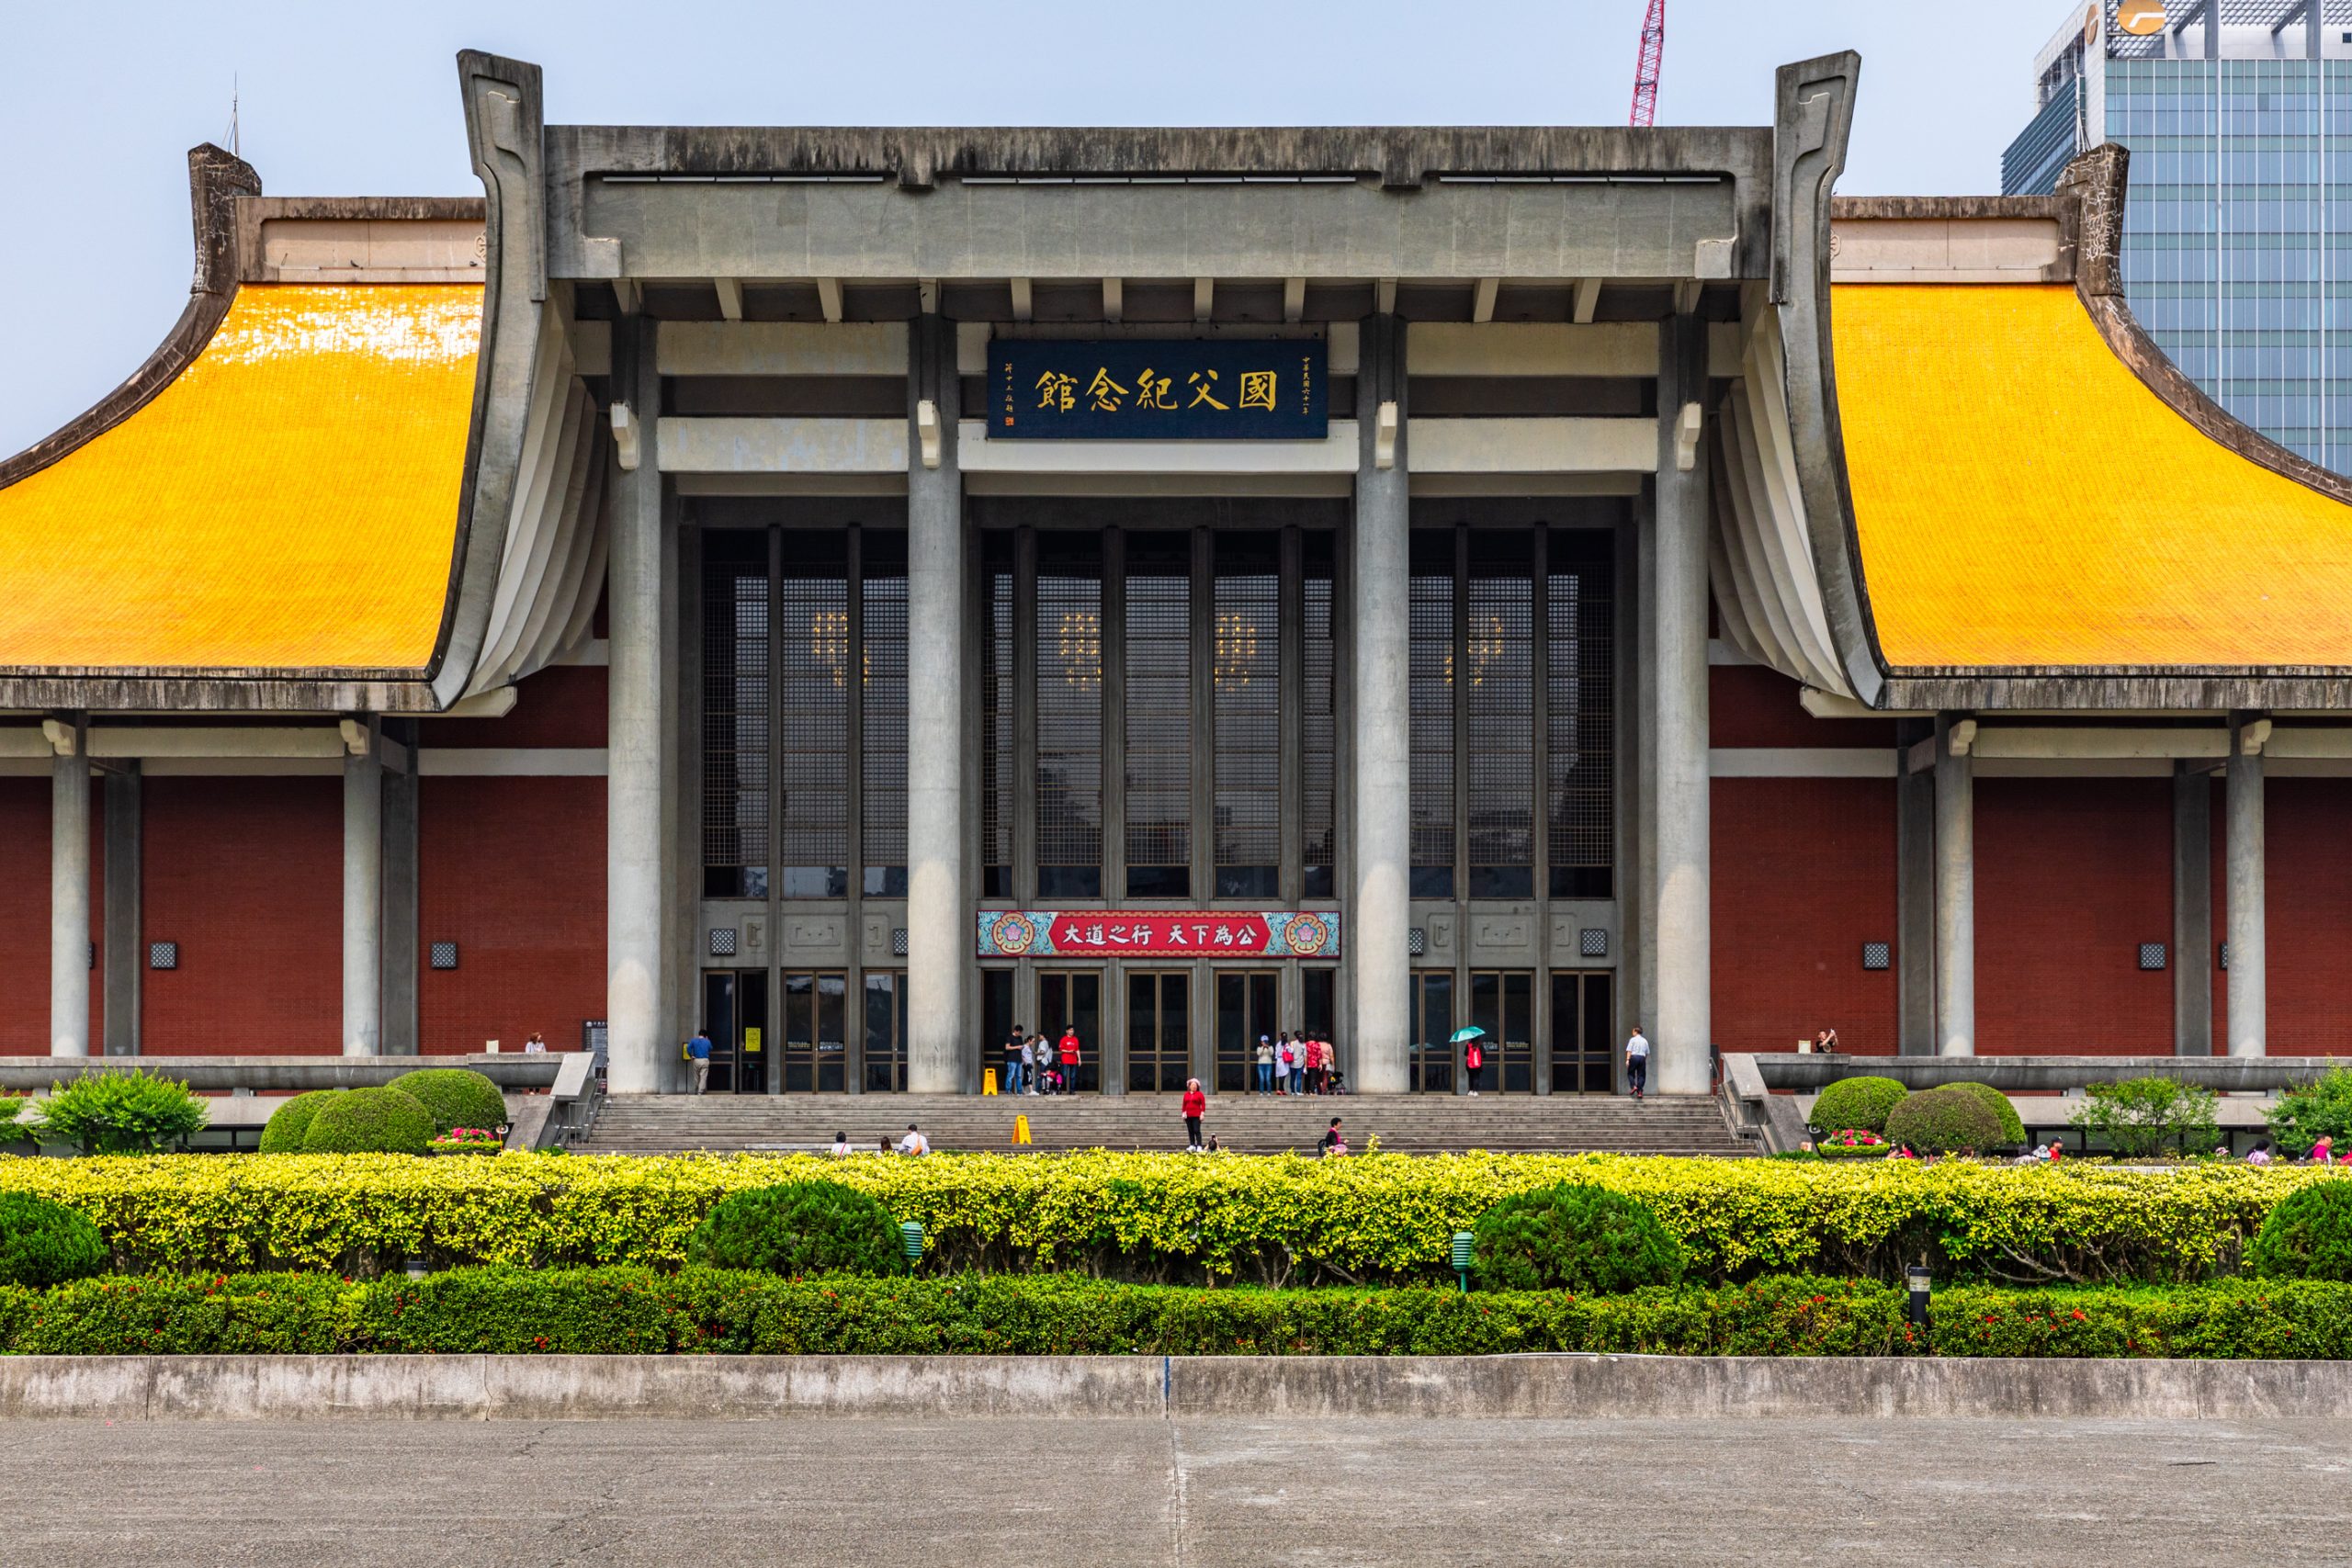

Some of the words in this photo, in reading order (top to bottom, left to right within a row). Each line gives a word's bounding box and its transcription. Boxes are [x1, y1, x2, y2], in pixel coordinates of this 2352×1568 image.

[1035, 367, 1277, 412] 國父紀念館
[1062, 923, 1154, 946] 大道之行
[1167, 923, 1258, 946] 天下為公
